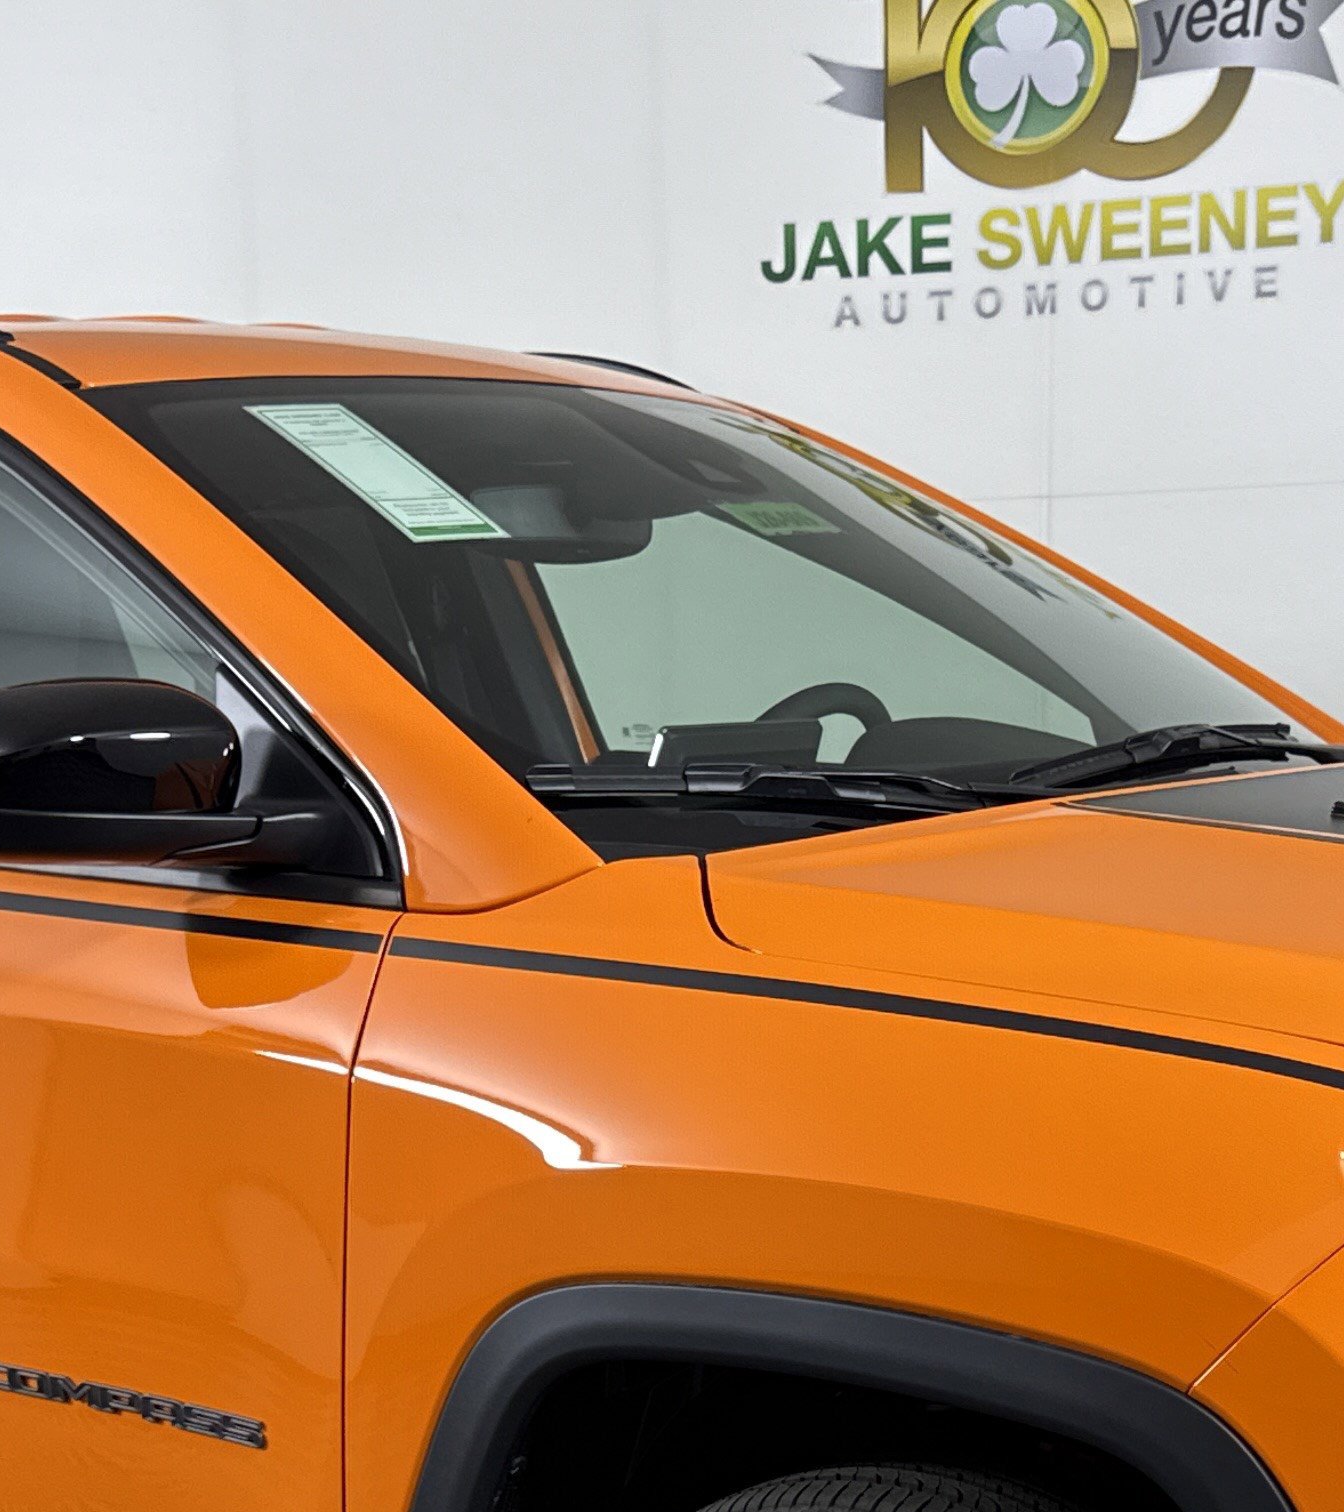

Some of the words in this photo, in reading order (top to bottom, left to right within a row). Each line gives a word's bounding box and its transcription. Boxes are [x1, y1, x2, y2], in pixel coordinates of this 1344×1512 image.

[1151, 0, 1307, 65] years
[760, 212, 953, 285] JAKE
[833, 265, 1279, 329] AUTOMOTIVE
